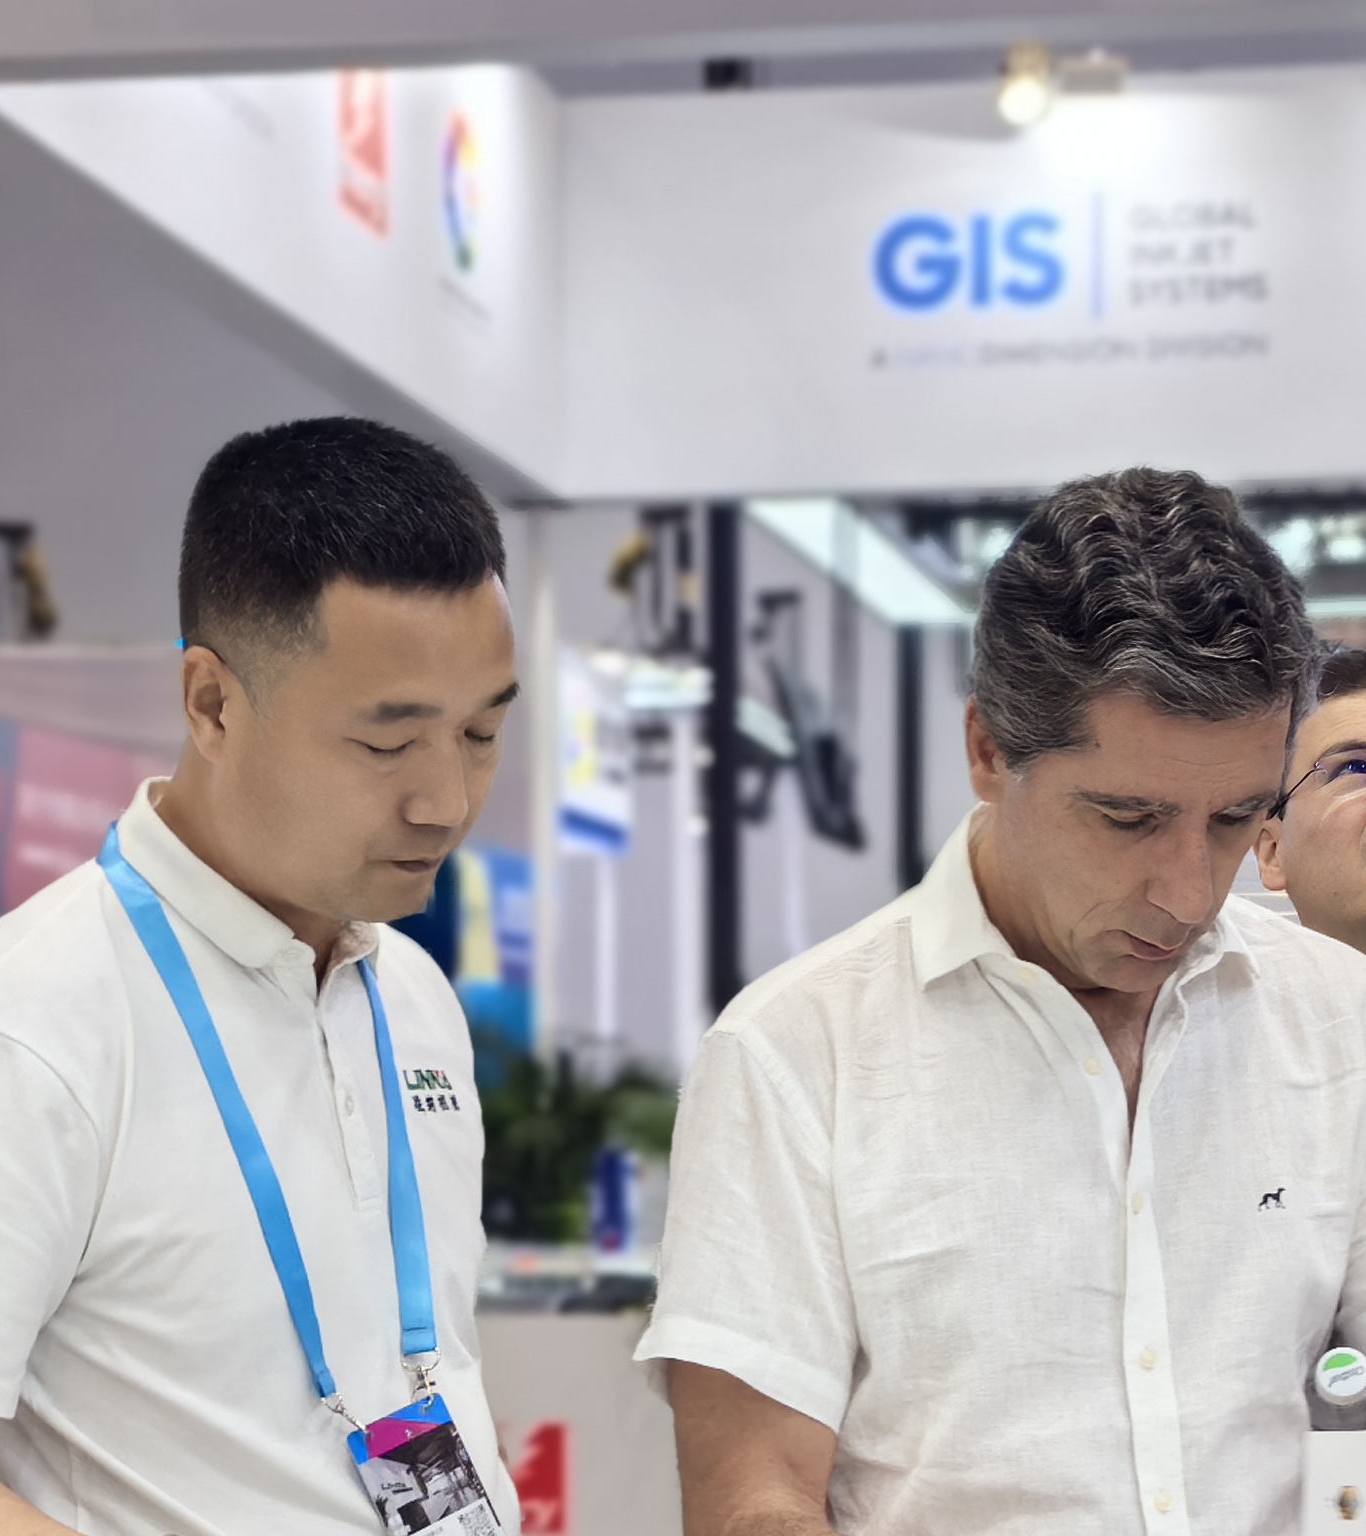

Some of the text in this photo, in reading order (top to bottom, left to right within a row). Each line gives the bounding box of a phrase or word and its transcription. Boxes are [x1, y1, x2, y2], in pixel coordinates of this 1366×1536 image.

[1130, 201, 1256, 231] GLOBAL
[873, 213, 1065, 312] GIS
[1130, 272, 1269, 306] SYSTEMS
